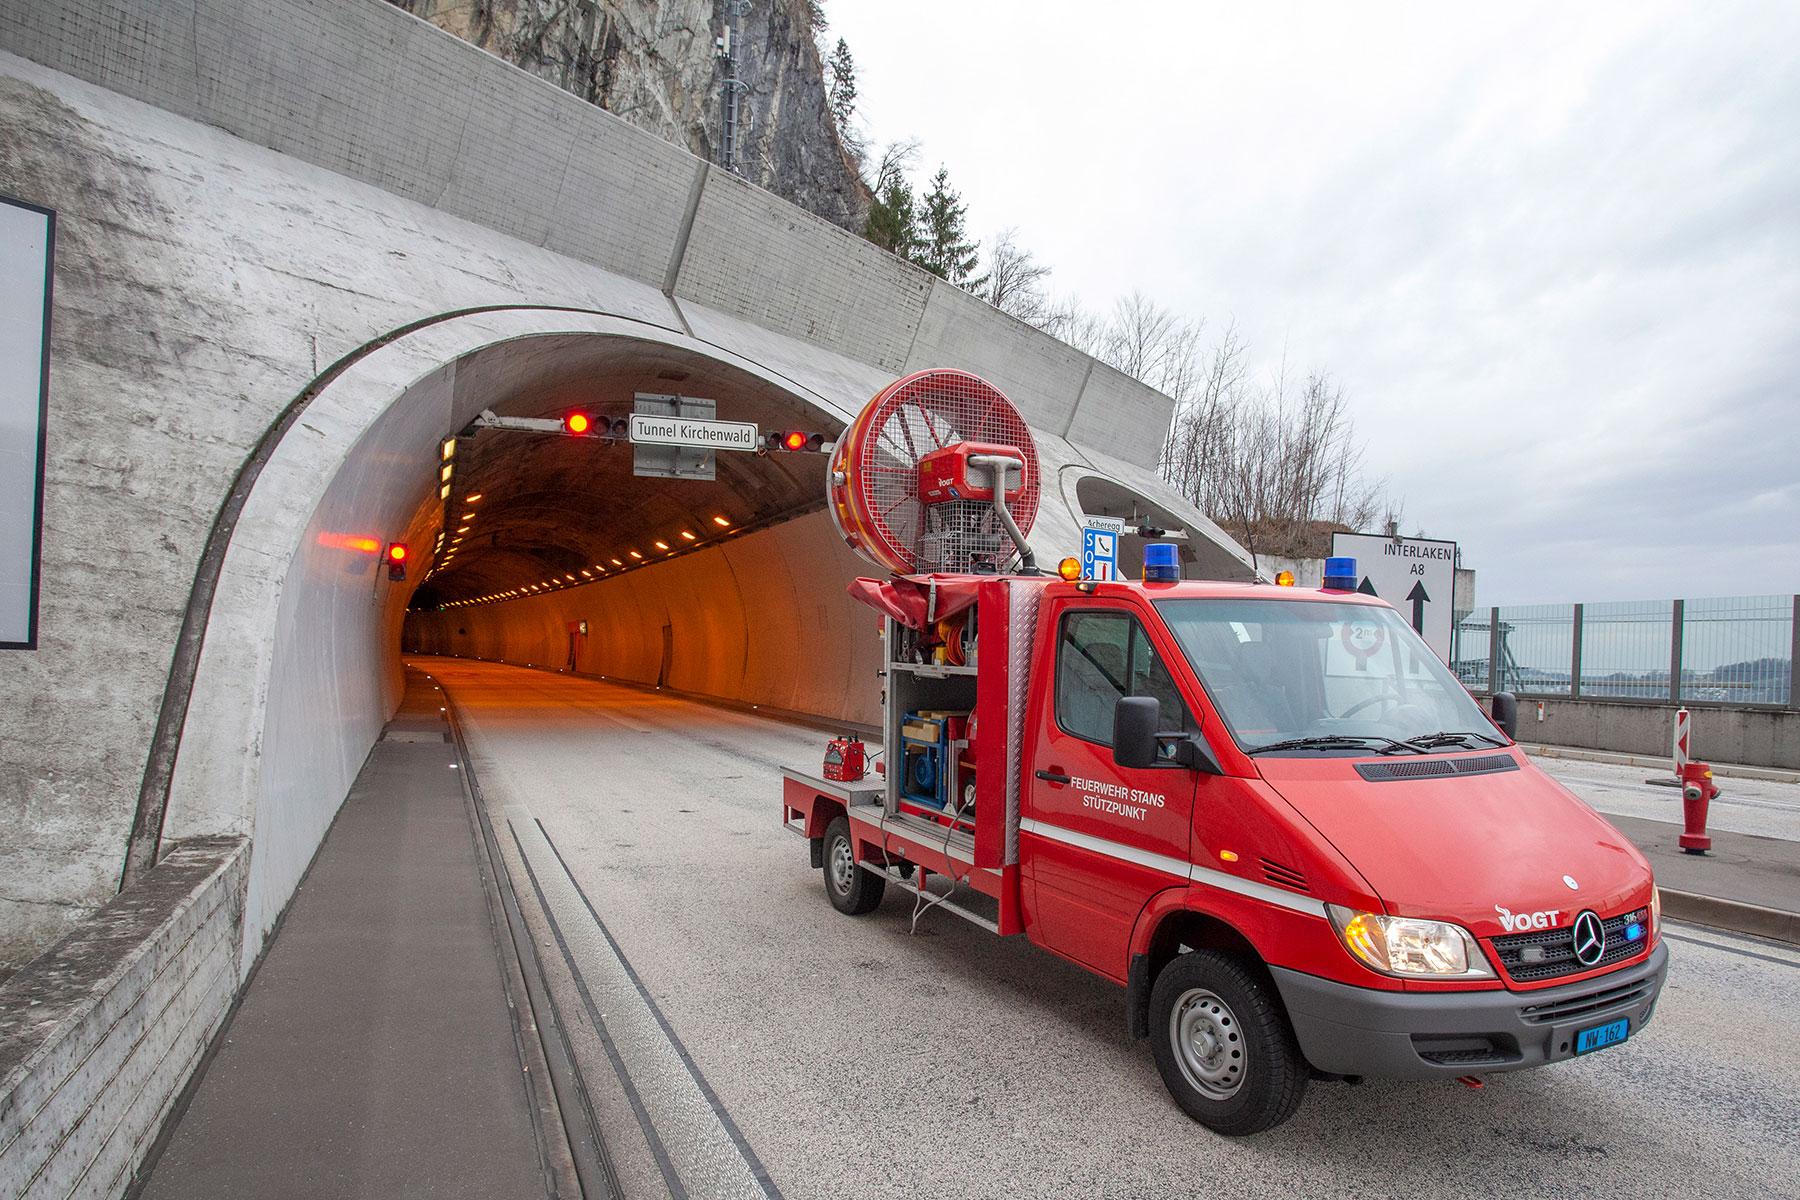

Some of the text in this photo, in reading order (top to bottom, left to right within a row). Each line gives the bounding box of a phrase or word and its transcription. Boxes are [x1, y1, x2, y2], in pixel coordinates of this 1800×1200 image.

[637, 421, 751, 443] Tunnel Kirchenwald
[1384, 543, 1452, 560] INTERLAKEN
[1410, 563, 1425, 576] A8
[1070, 776, 1166, 808] FEUERWEHR STANS
[1082, 795, 1147, 821] STÜTZPUNKT
[1494, 904, 1560, 932] VOGT
[1604, 1024, 1621, 1043] 162
